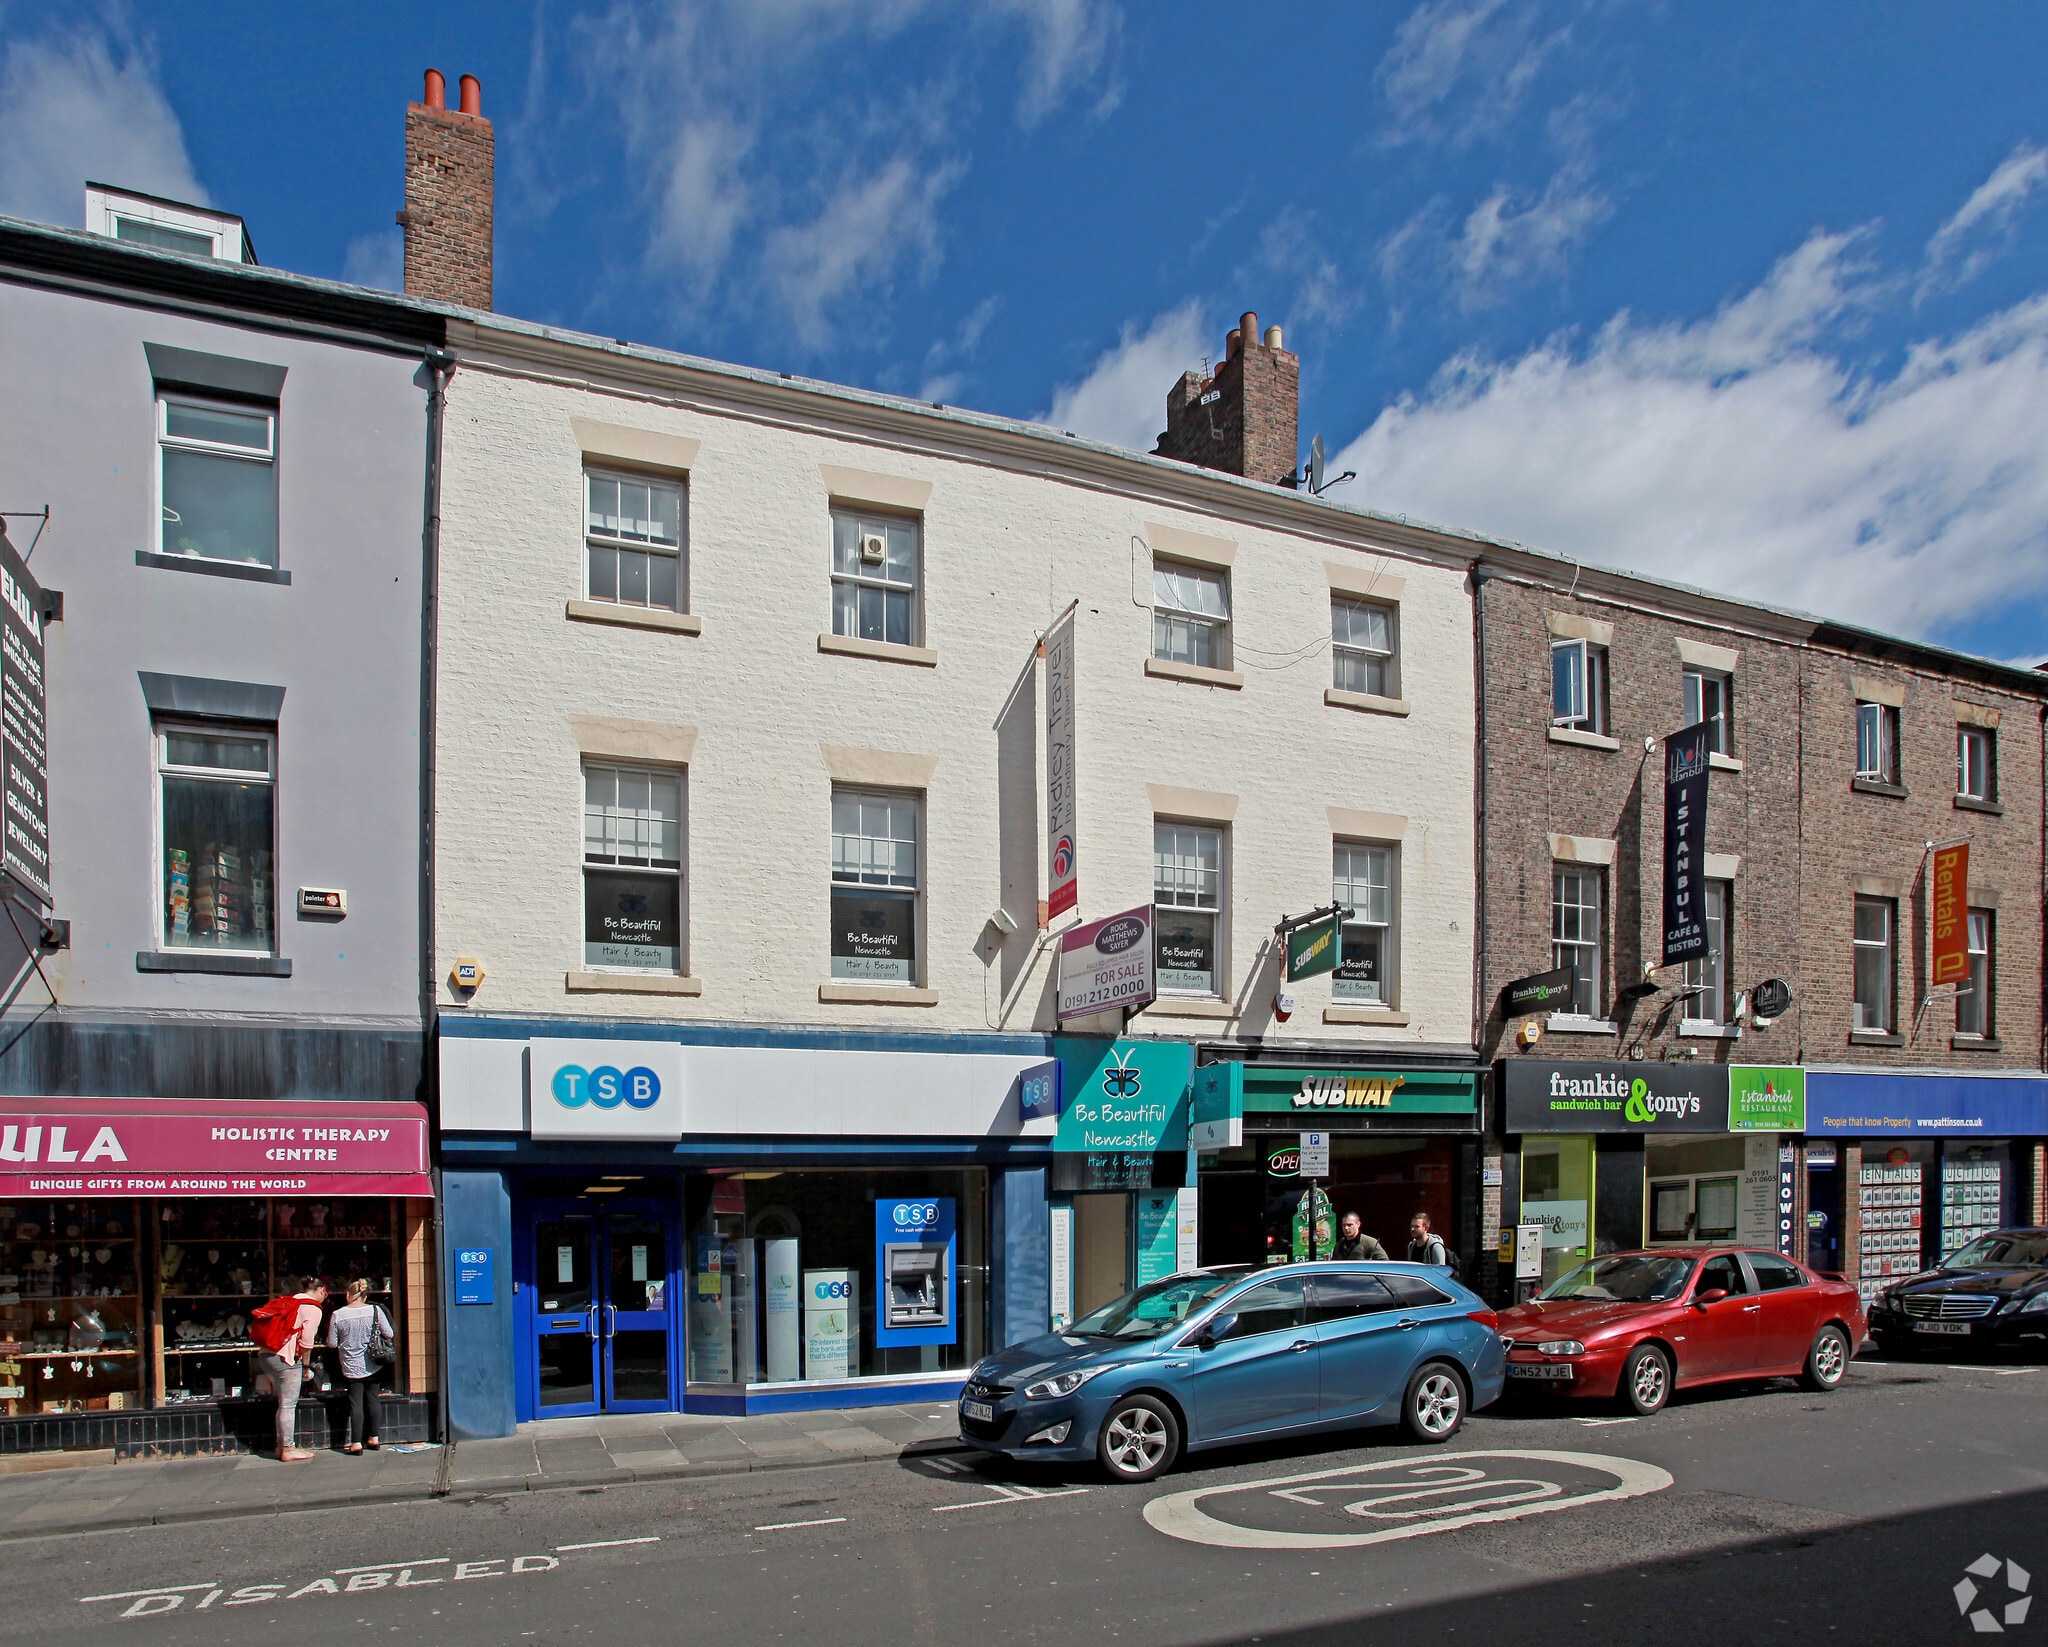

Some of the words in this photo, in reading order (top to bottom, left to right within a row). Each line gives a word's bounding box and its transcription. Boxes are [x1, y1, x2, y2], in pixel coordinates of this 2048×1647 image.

[0, 564, 42, 646] ELULA
[2, 638, 27, 676] UNIQUE
[4, 623, 21, 652] FAIR
[22, 644, 41, 678] TRADE
[1049, 641, 1062, 736] Travel
[1063, 665, 1071, 731] Travel
[10, 763, 36, 800] SILVER
[36, 790, 43, 808] &
[1051, 742, 1064, 834] Ridley
[6, 790, 47, 840] GEMSTONE
[7, 820, 48, 866] JEWELLERY
[1676, 788, 1690, 924] ISTANBUL
[1936, 852, 1958, 939] Rentals
[604, 917, 619, 928] Be
[620, 918, 661, 931] Beautiful
[1110, 922, 1129, 934] ROOK
[611, 931, 652, 942] Newcastle
[847, 932, 860, 943] Be
[861, 933, 898, 945] Beautiful
[1101, 927, 1138, 945] MATTHEWS
[1667, 925, 1691, 941] CAFÉ
[1692, 924, 1700, 935] &
[854, 945, 892, 956] Newcastle
[1109, 940, 1129, 952] SAYER
[1162, 946, 1173, 956] Be
[1173, 947, 1204, 958] Beautiful
[1293, 928, 1334, 972] SUBWAY
[1667, 936, 1702, 954] BISTRO
[602, 946, 620, 955] Hair
[624, 947, 630, 958] &
[634, 947, 662, 962] Beauty
[846, 960, 861, 968] Hair
[865, 960, 871, 970] &
[874, 961, 899, 974] Beauty
[1167, 958, 1198, 968] Newcastle
[1346, 958, 1373, 969] Beautiful
[460, 967, 474, 976] ADT
[1095, 969, 1116, 987] FOR
[1117, 961, 1145, 981] SALE
[1160, 971, 1173, 979] Hair
[1183, 972, 1204, 985] Beauty
[1340, 970, 1368, 979] Newcastle
[1064, 989, 1087, 1009] 0191
[1089, 986, 1110, 999] 212
[1112, 979, 1145, 998] 0000
[1335, 982, 1347, 990] Hair
[1354, 983, 1373, 994] Beauty
[1512, 985, 1540, 999] frankie
[1537, 985, 1550, 1000] &
[1545, 983, 1568, 995] tony's
[560, 1072, 654, 1102] TSB
[1024, 1080, 1050, 1102] TSB
[1293, 1075, 1405, 1107] SUBWAY
[1550, 1072, 1629, 1097] frankie
[1625, 1078, 1657, 1123] &
[1646, 1091, 1700, 1119] tony's
[1550, 1098, 1601, 1110] sandwich
[1603, 1099, 1622, 1110] bar
[1741, 1089, 1793, 1103] Istanbul
[1075, 1104, 1098, 1121] Be
[1101, 1104, 1166, 1122] Beautiful
[1741, 1104, 1792, 1112] RESTAURANT
[1823, 1117, 1846, 1127] People
[1848, 1117, 1862, 1126] that
[1864, 1117, 1882, 1126] know
[1883, 1117, 1911, 1128] Property
[1916, 1118, 1982, 1128] www.pattinson.co.uk
[212, 1128, 295, 1141] HOLISTIC
[302, 1128, 390, 1142] THERAPY
[1084, 1130, 1157, 1147] Newcastle
[1312, 1135, 1319, 1145] P
[0, 1125, 128, 1162] ULA
[265, 1148, 338, 1161] CENTRE
[1087, 1156, 1108, 1167] Hair
[1112, 1155, 1118, 1169] &
[29, 1180, 82, 1190] UNIQUE
[87, 1179, 123, 1189] GIFTS
[127, 1179, 166, 1189] FROM
[170, 1179, 227, 1189] AROUND
[232, 1180, 256, 1189] THE
[260, 1179, 307, 1189] WORLD
[1780, 1172, 1792, 1214] NOW
[897, 1207, 936, 1222] TSB
[1523, 1215, 1555, 1225] frankie
[1552, 1216, 1566, 1234] &
[1562, 1220, 1585, 1231] tony's
[1502, 1233, 1509, 1243] P
[463, 1254, 485, 1262] TSB
[817, 1284, 850, 1297] TSB
[1943, 1323, 1963, 1332] VDK
[1513, 1366, 1541, 1377] GN52
[1545, 1367, 1567, 1377] VJE
[1269, 1467, 1563, 1518] 20
[121, 1555, 558, 1617] DISABLED
